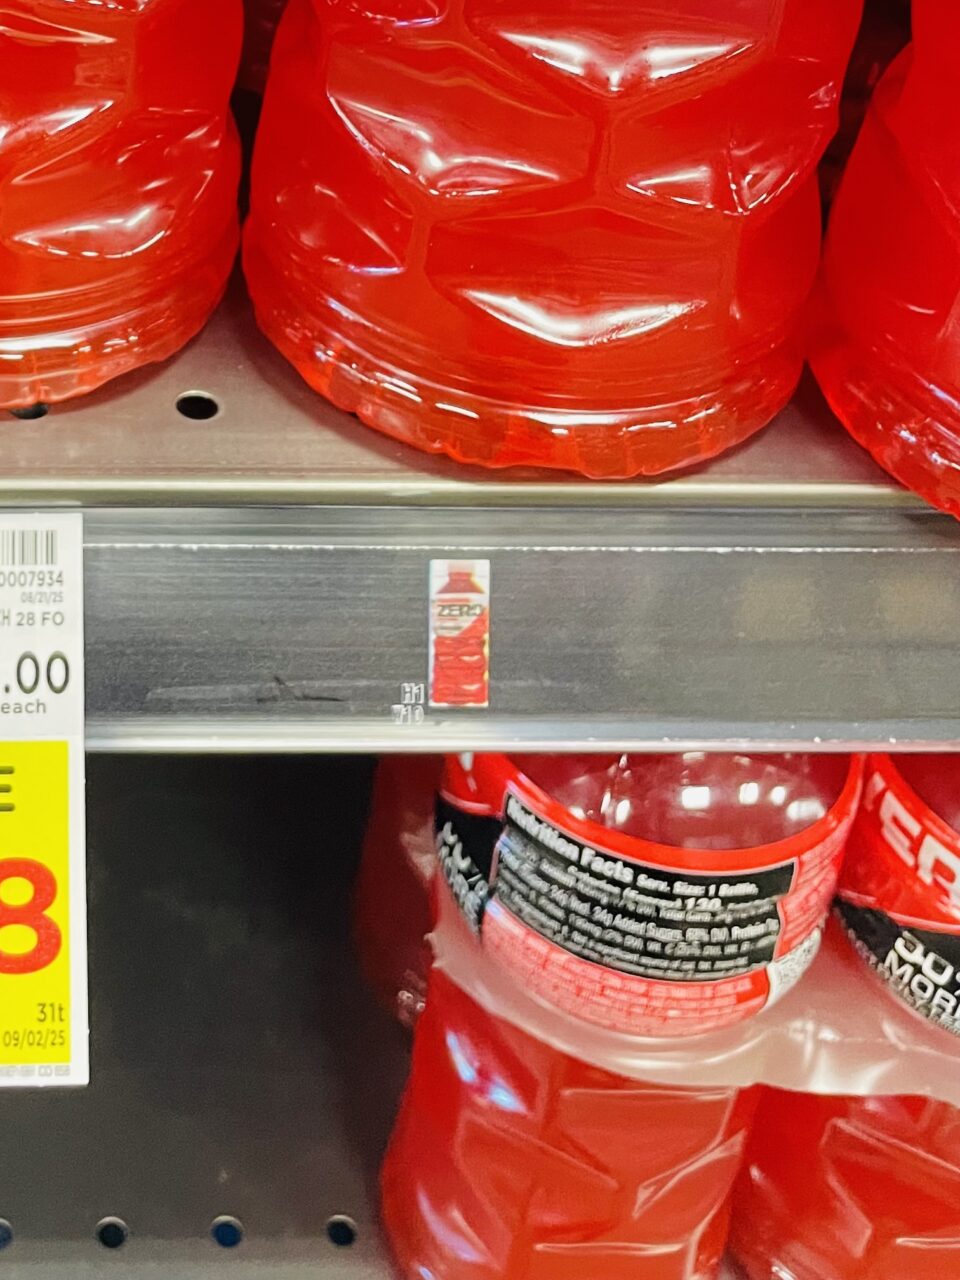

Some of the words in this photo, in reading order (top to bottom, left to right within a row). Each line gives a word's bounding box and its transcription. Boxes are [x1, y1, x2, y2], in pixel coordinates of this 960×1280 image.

[16, 611, 35, 626] 28
[41, 611, 65, 626] FO
[0, 698, 47, 714] each
[580, 847, 634, 884] Facts
[884, 949, 960, 1016] MOR
[37, 1002, 64, 1023] 31t
[2, 1030, 66, 1049] 09/02/25
